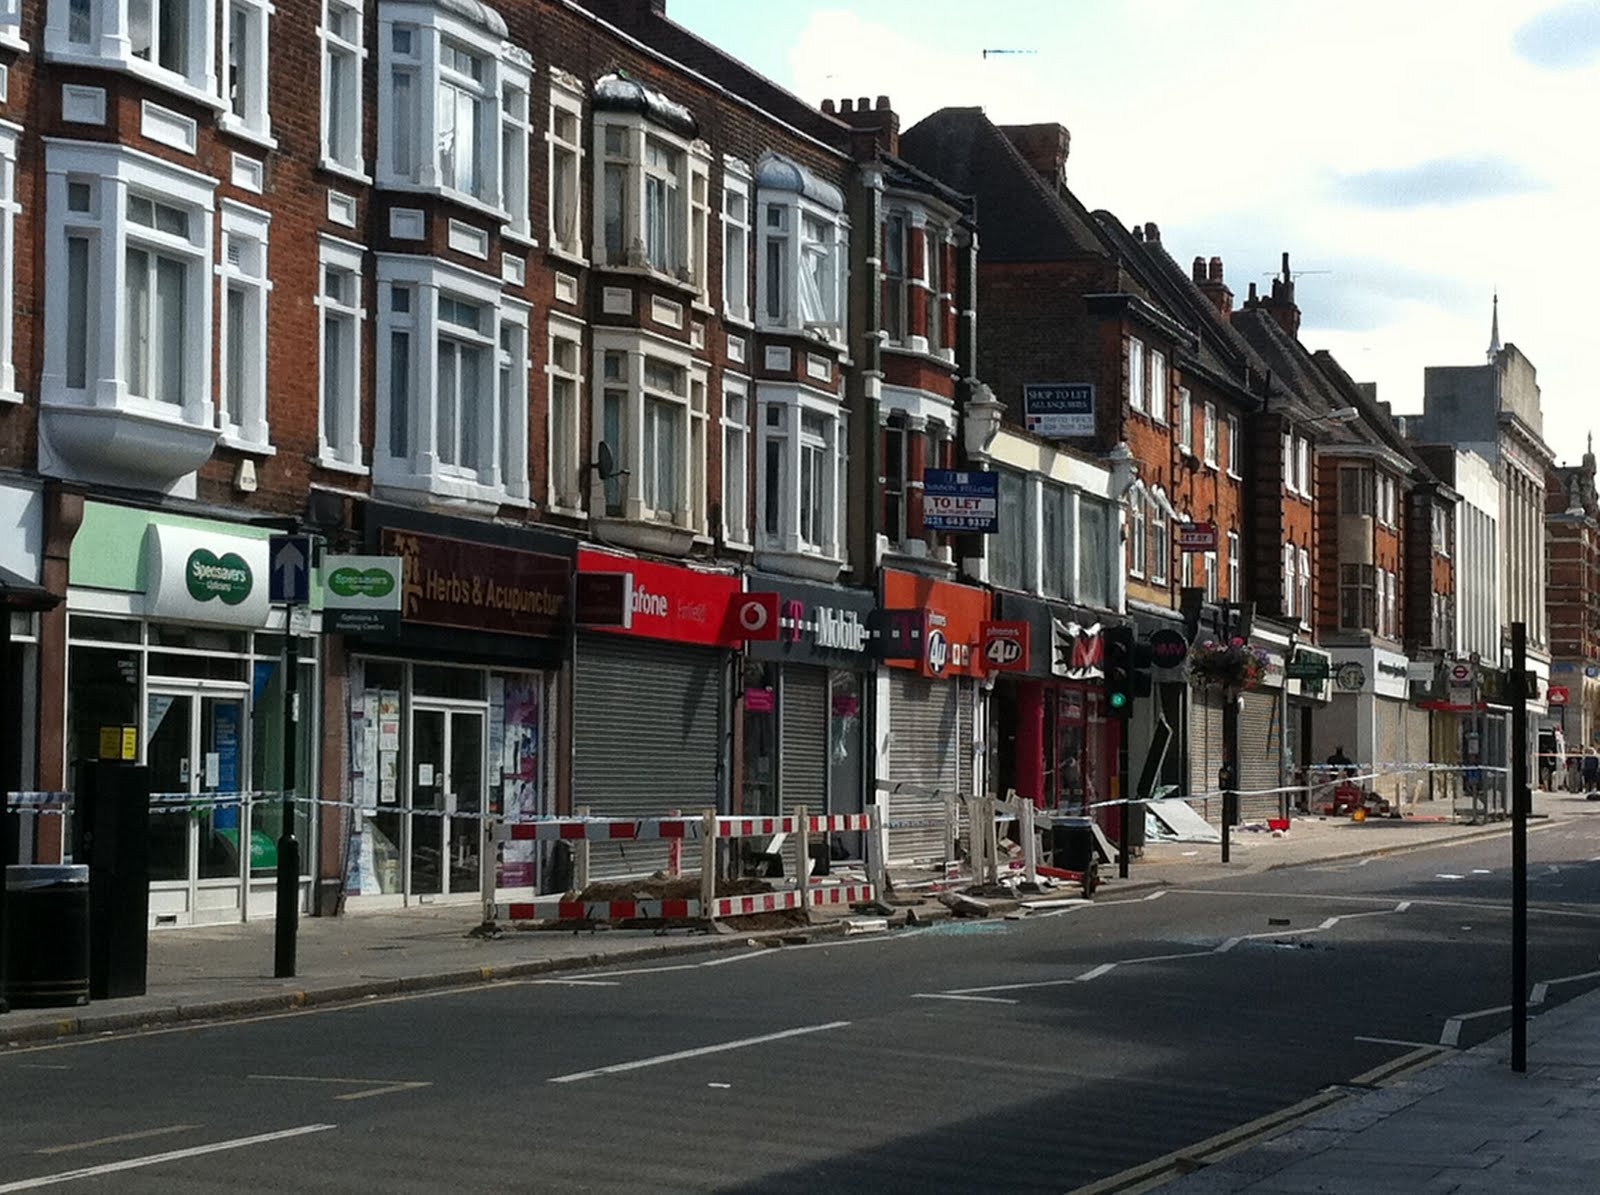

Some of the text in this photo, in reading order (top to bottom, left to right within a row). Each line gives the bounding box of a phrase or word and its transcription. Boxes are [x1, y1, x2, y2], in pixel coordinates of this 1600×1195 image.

[1055, 391, 1070, 400] TO
[1071, 391, 1089, 400] LET
[932, 497, 981, 510] TO LET
[192, 560, 246, 583] Specsavers
[335, 573, 389, 585] Specsavers
[426, 568, 470, 604] Herbs
[472, 575, 483, 606] &
[986, 627, 1020, 637] phones
